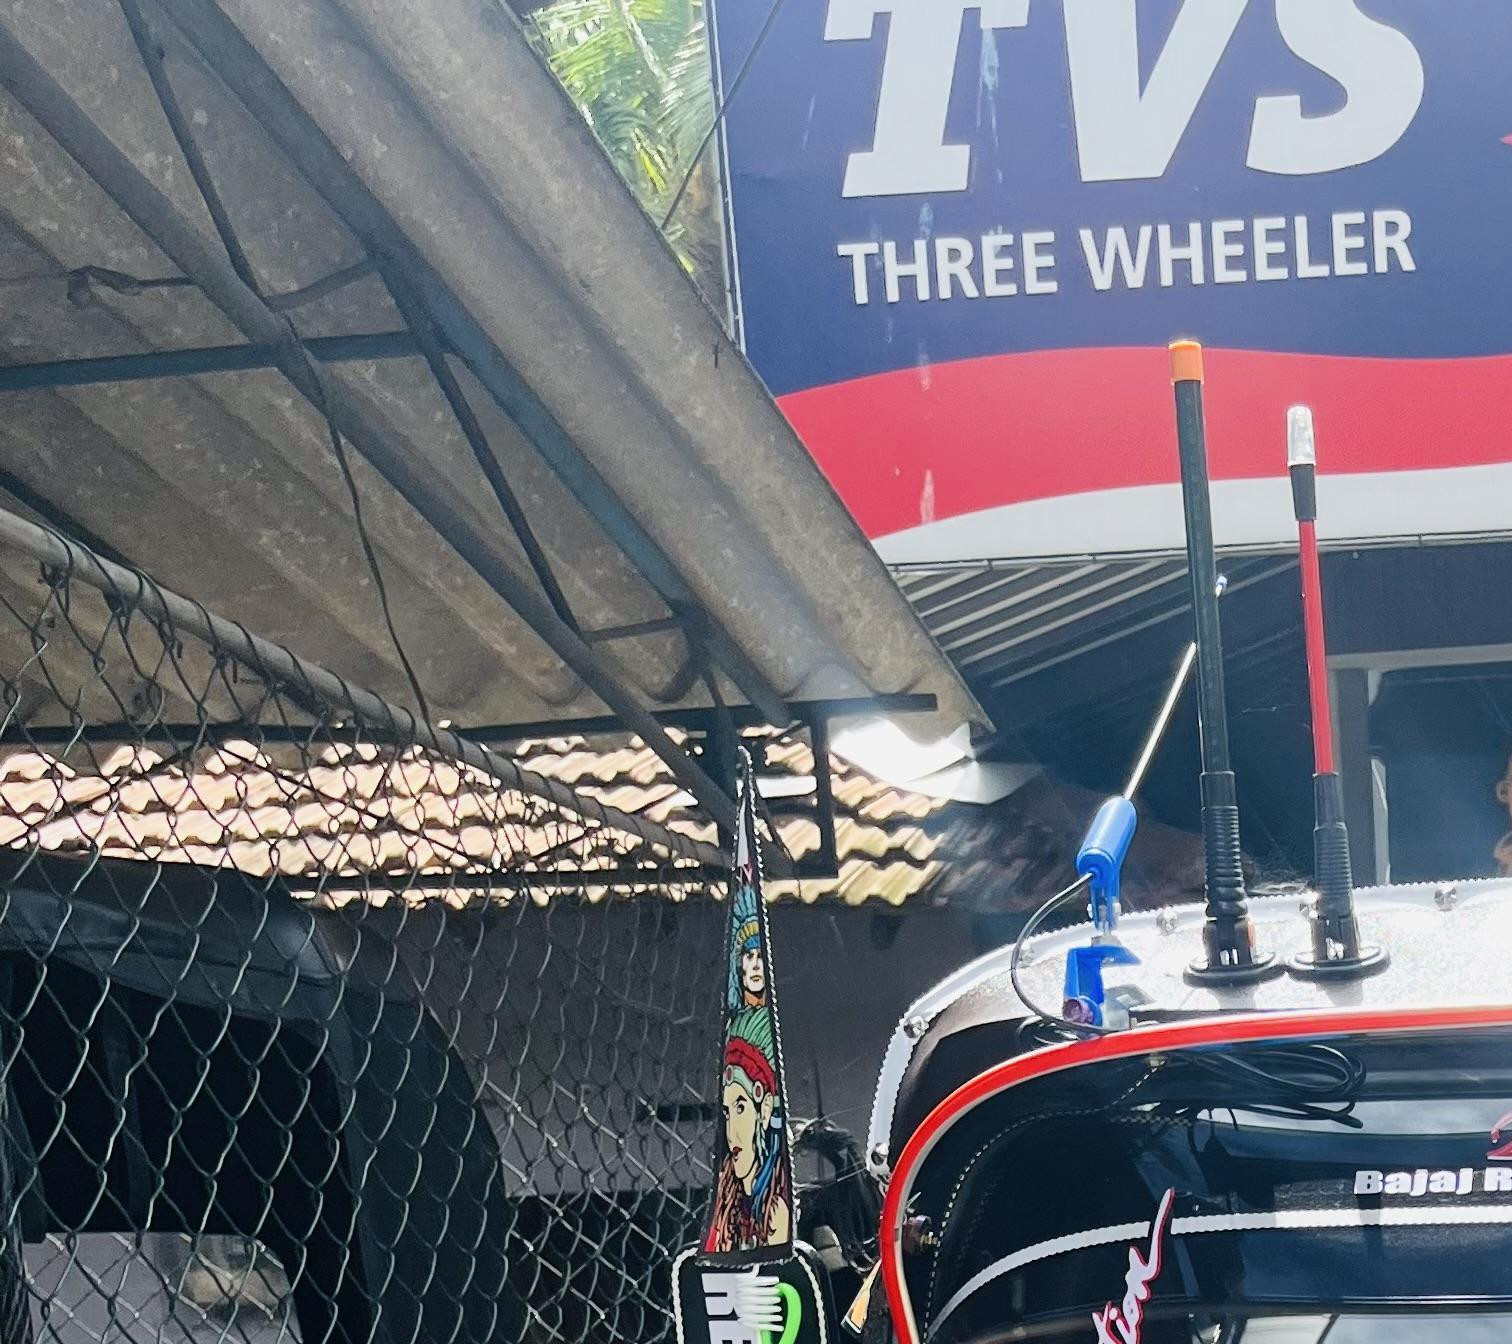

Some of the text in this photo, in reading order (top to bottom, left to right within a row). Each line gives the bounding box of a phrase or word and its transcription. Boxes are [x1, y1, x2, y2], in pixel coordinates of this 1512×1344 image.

[824, 0, 1425, 197] TVS
[837, 210, 1416, 305] THREE WHEELER
[1353, 1167, 1473, 1197] Bajaj
